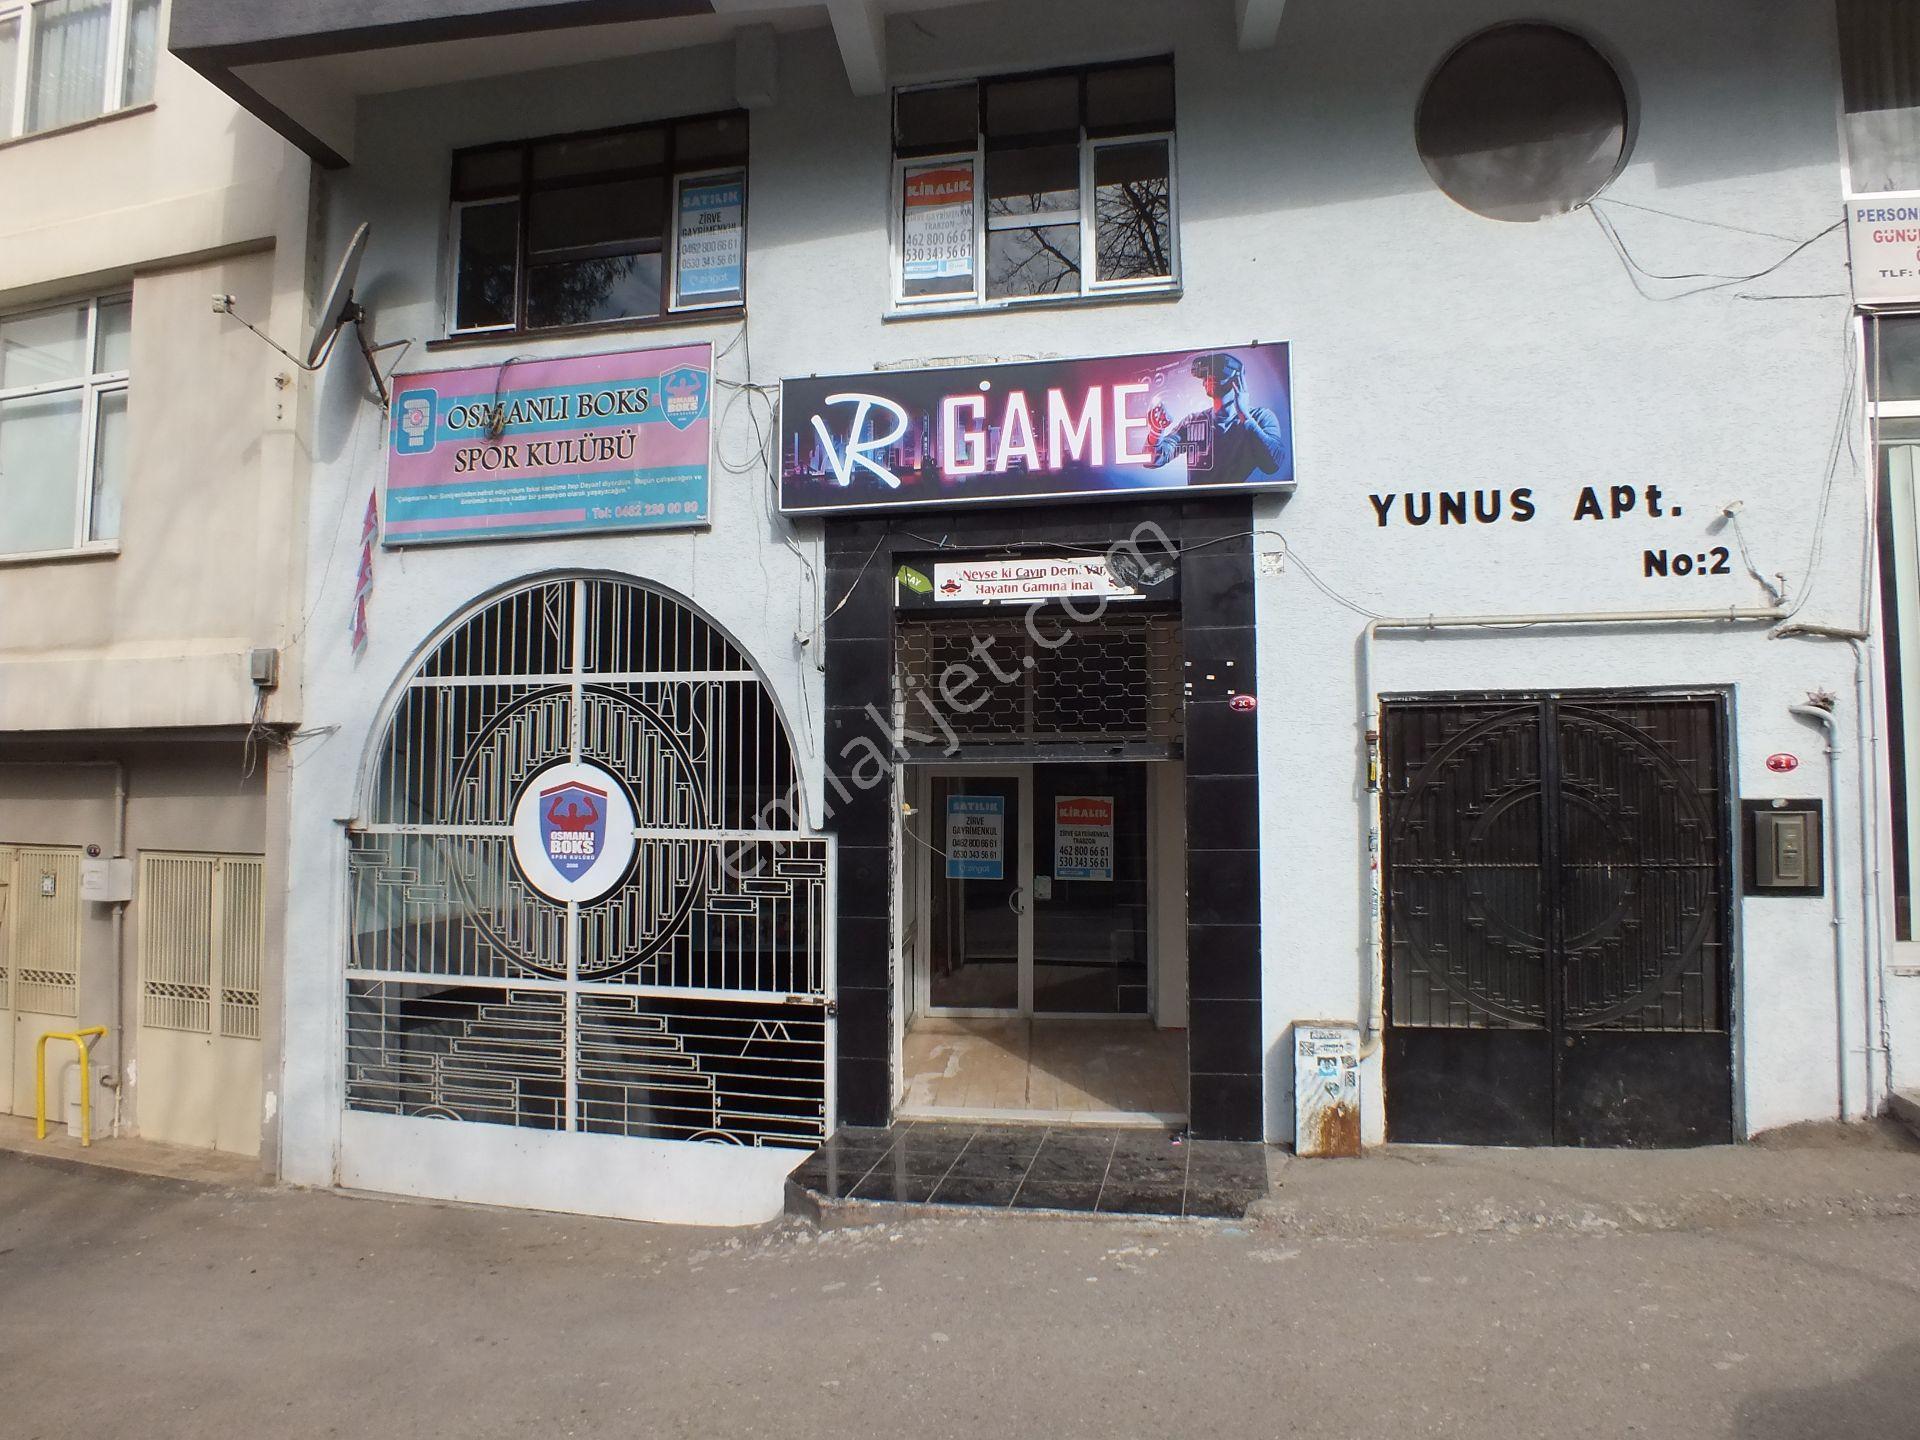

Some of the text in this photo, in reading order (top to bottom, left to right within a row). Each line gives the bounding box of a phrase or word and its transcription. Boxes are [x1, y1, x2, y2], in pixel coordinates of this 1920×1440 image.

[906, 233, 924, 247] 462
[927, 231, 944, 245] 800
[946, 230, 958, 243] 66
[906, 244, 972, 262] 530 343 56 61
[1879, 269, 1913, 278] TLF:
[447, 387, 649, 430] OSMANLI BOKS
[943, 381, 1156, 476] GAME
[454, 429, 637, 473] SPOR KULÜBÜ
[1369, 484, 1682, 527] YUNUS Apt.
[1643, 546, 1731, 578] No:2
[966, 816, 984, 826] ZİRVE
[550, 831, 595, 841] OSMANLI
[952, 825, 998, 836] GAYRİMENKUL
[550, 841, 595, 854] BOKS
[1059, 845, 1073, 856] 462
[1074, 846, 1088, 856] 800
[1089, 846, 1099, 856] 66
[1059, 857, 1073, 867] 530
[1089, 857, 1099, 867] 56
